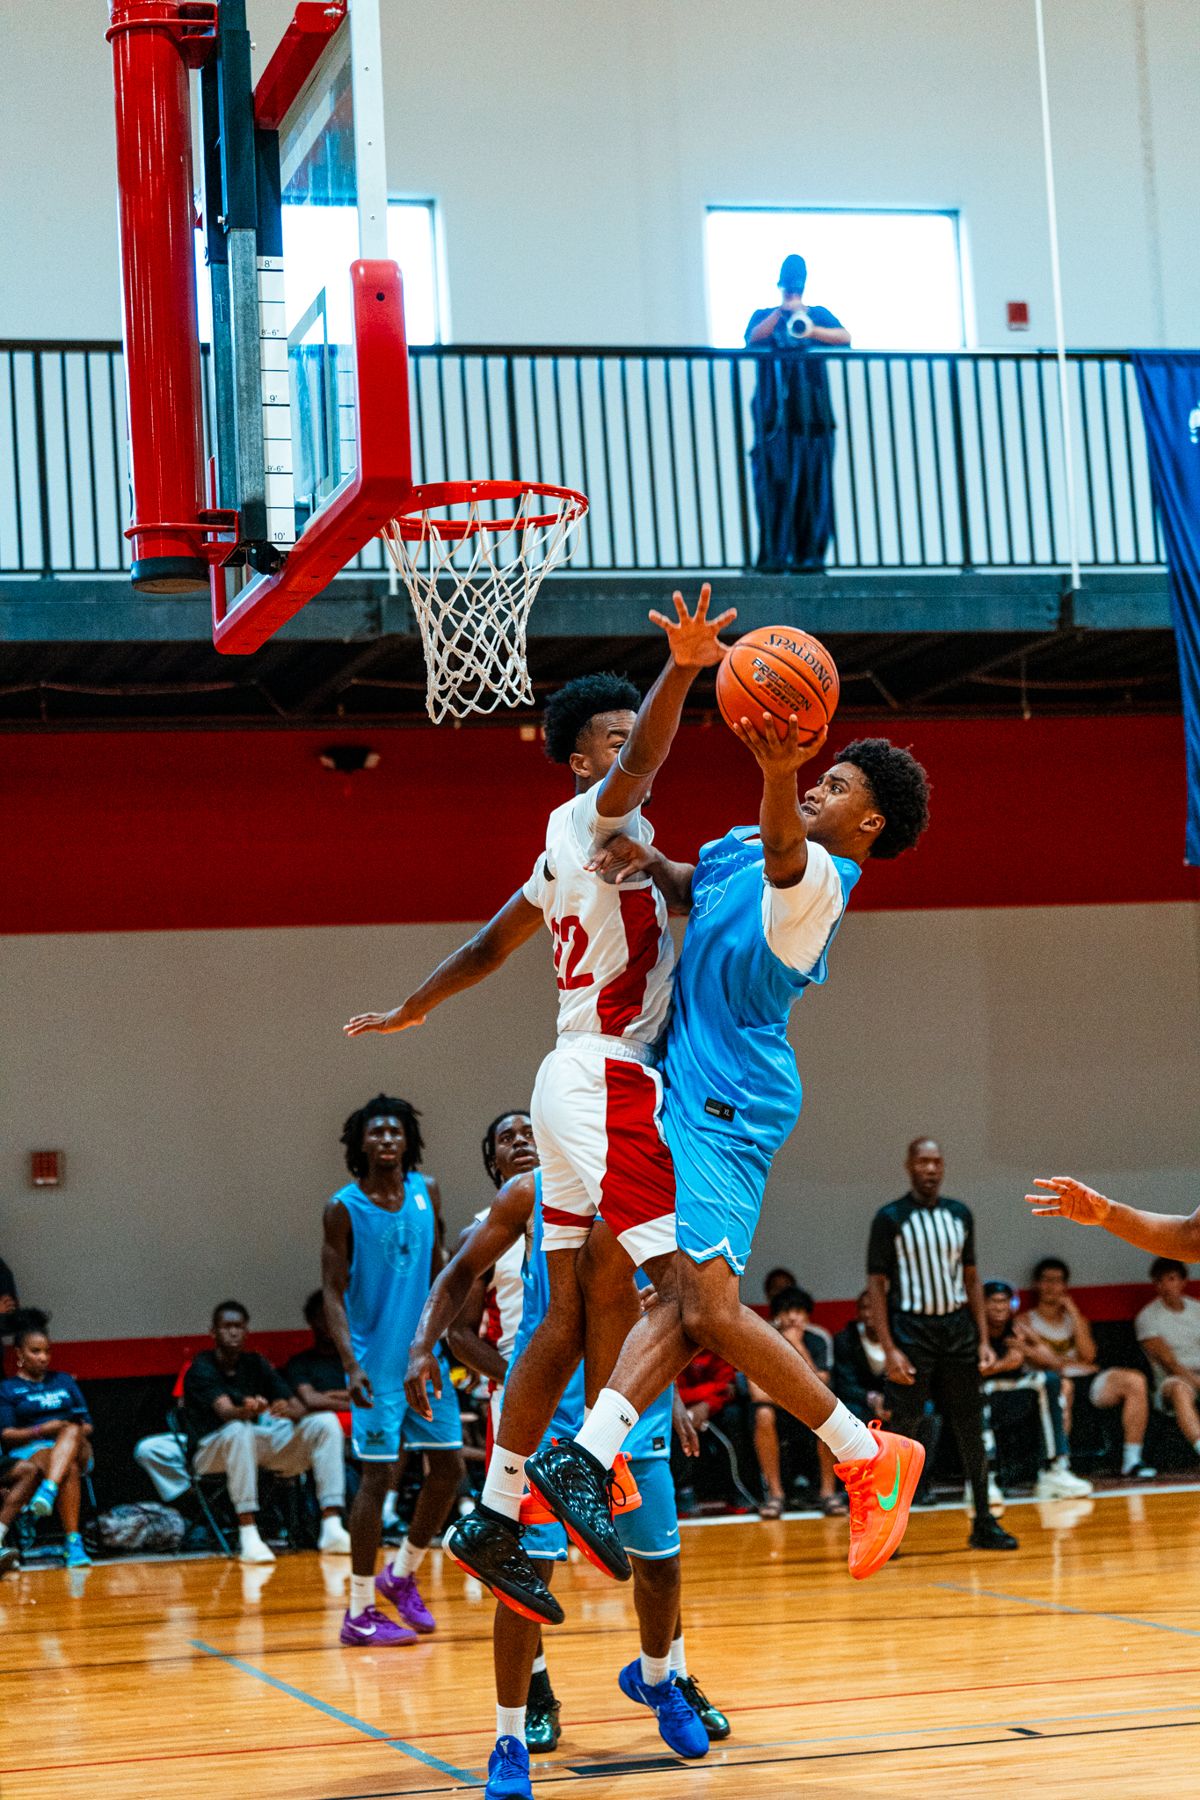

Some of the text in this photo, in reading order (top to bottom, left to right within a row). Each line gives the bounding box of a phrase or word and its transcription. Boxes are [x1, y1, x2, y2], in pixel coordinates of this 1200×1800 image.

[264, 260, 273, 268] 8'
[269, 394, 278, 403] 9'
[274, 532, 286, 541] 10'
[764, 633, 832, 695] SPALDING
[751, 657, 813, 711] PRECISION
